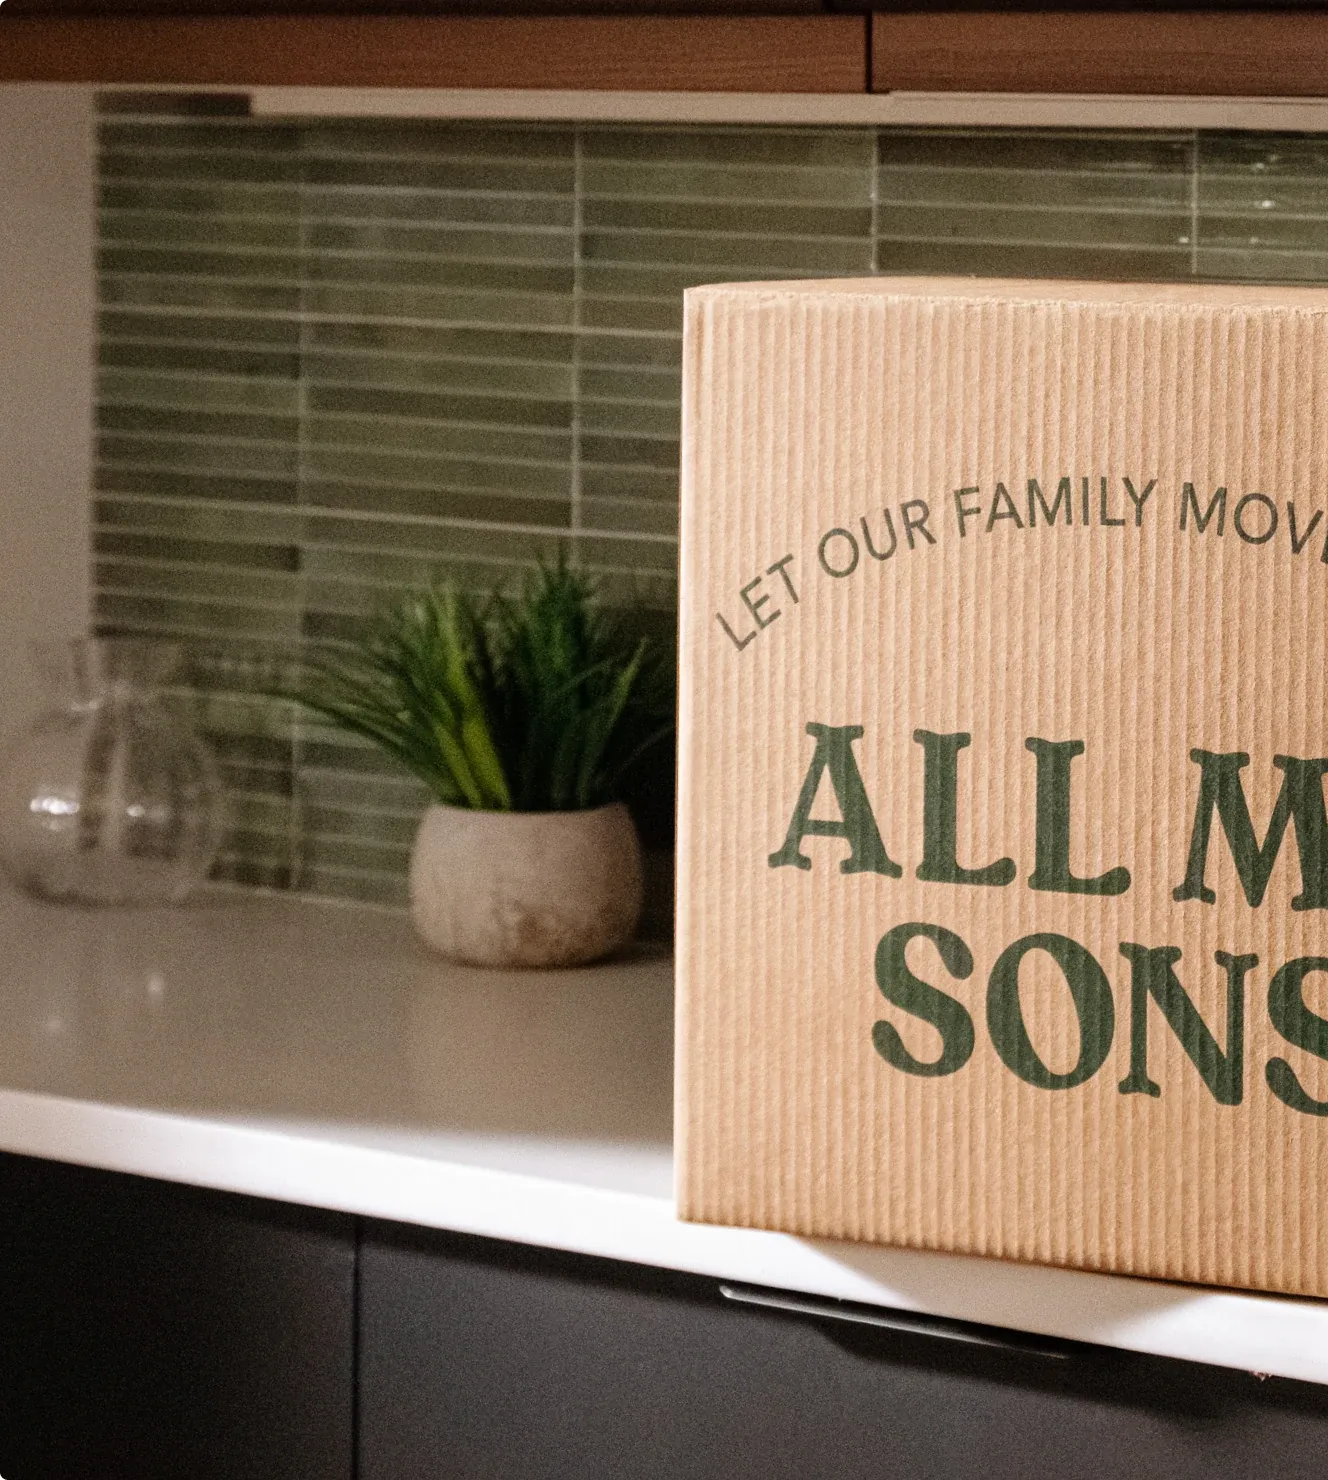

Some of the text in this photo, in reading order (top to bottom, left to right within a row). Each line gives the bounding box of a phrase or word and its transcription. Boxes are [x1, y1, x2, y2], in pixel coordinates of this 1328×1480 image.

[716, 554, 801, 651] LET
[817, 499, 937, 578] OUR
[953, 476, 1159, 538] FAMILY
[768, 722, 1131, 897] ALL
